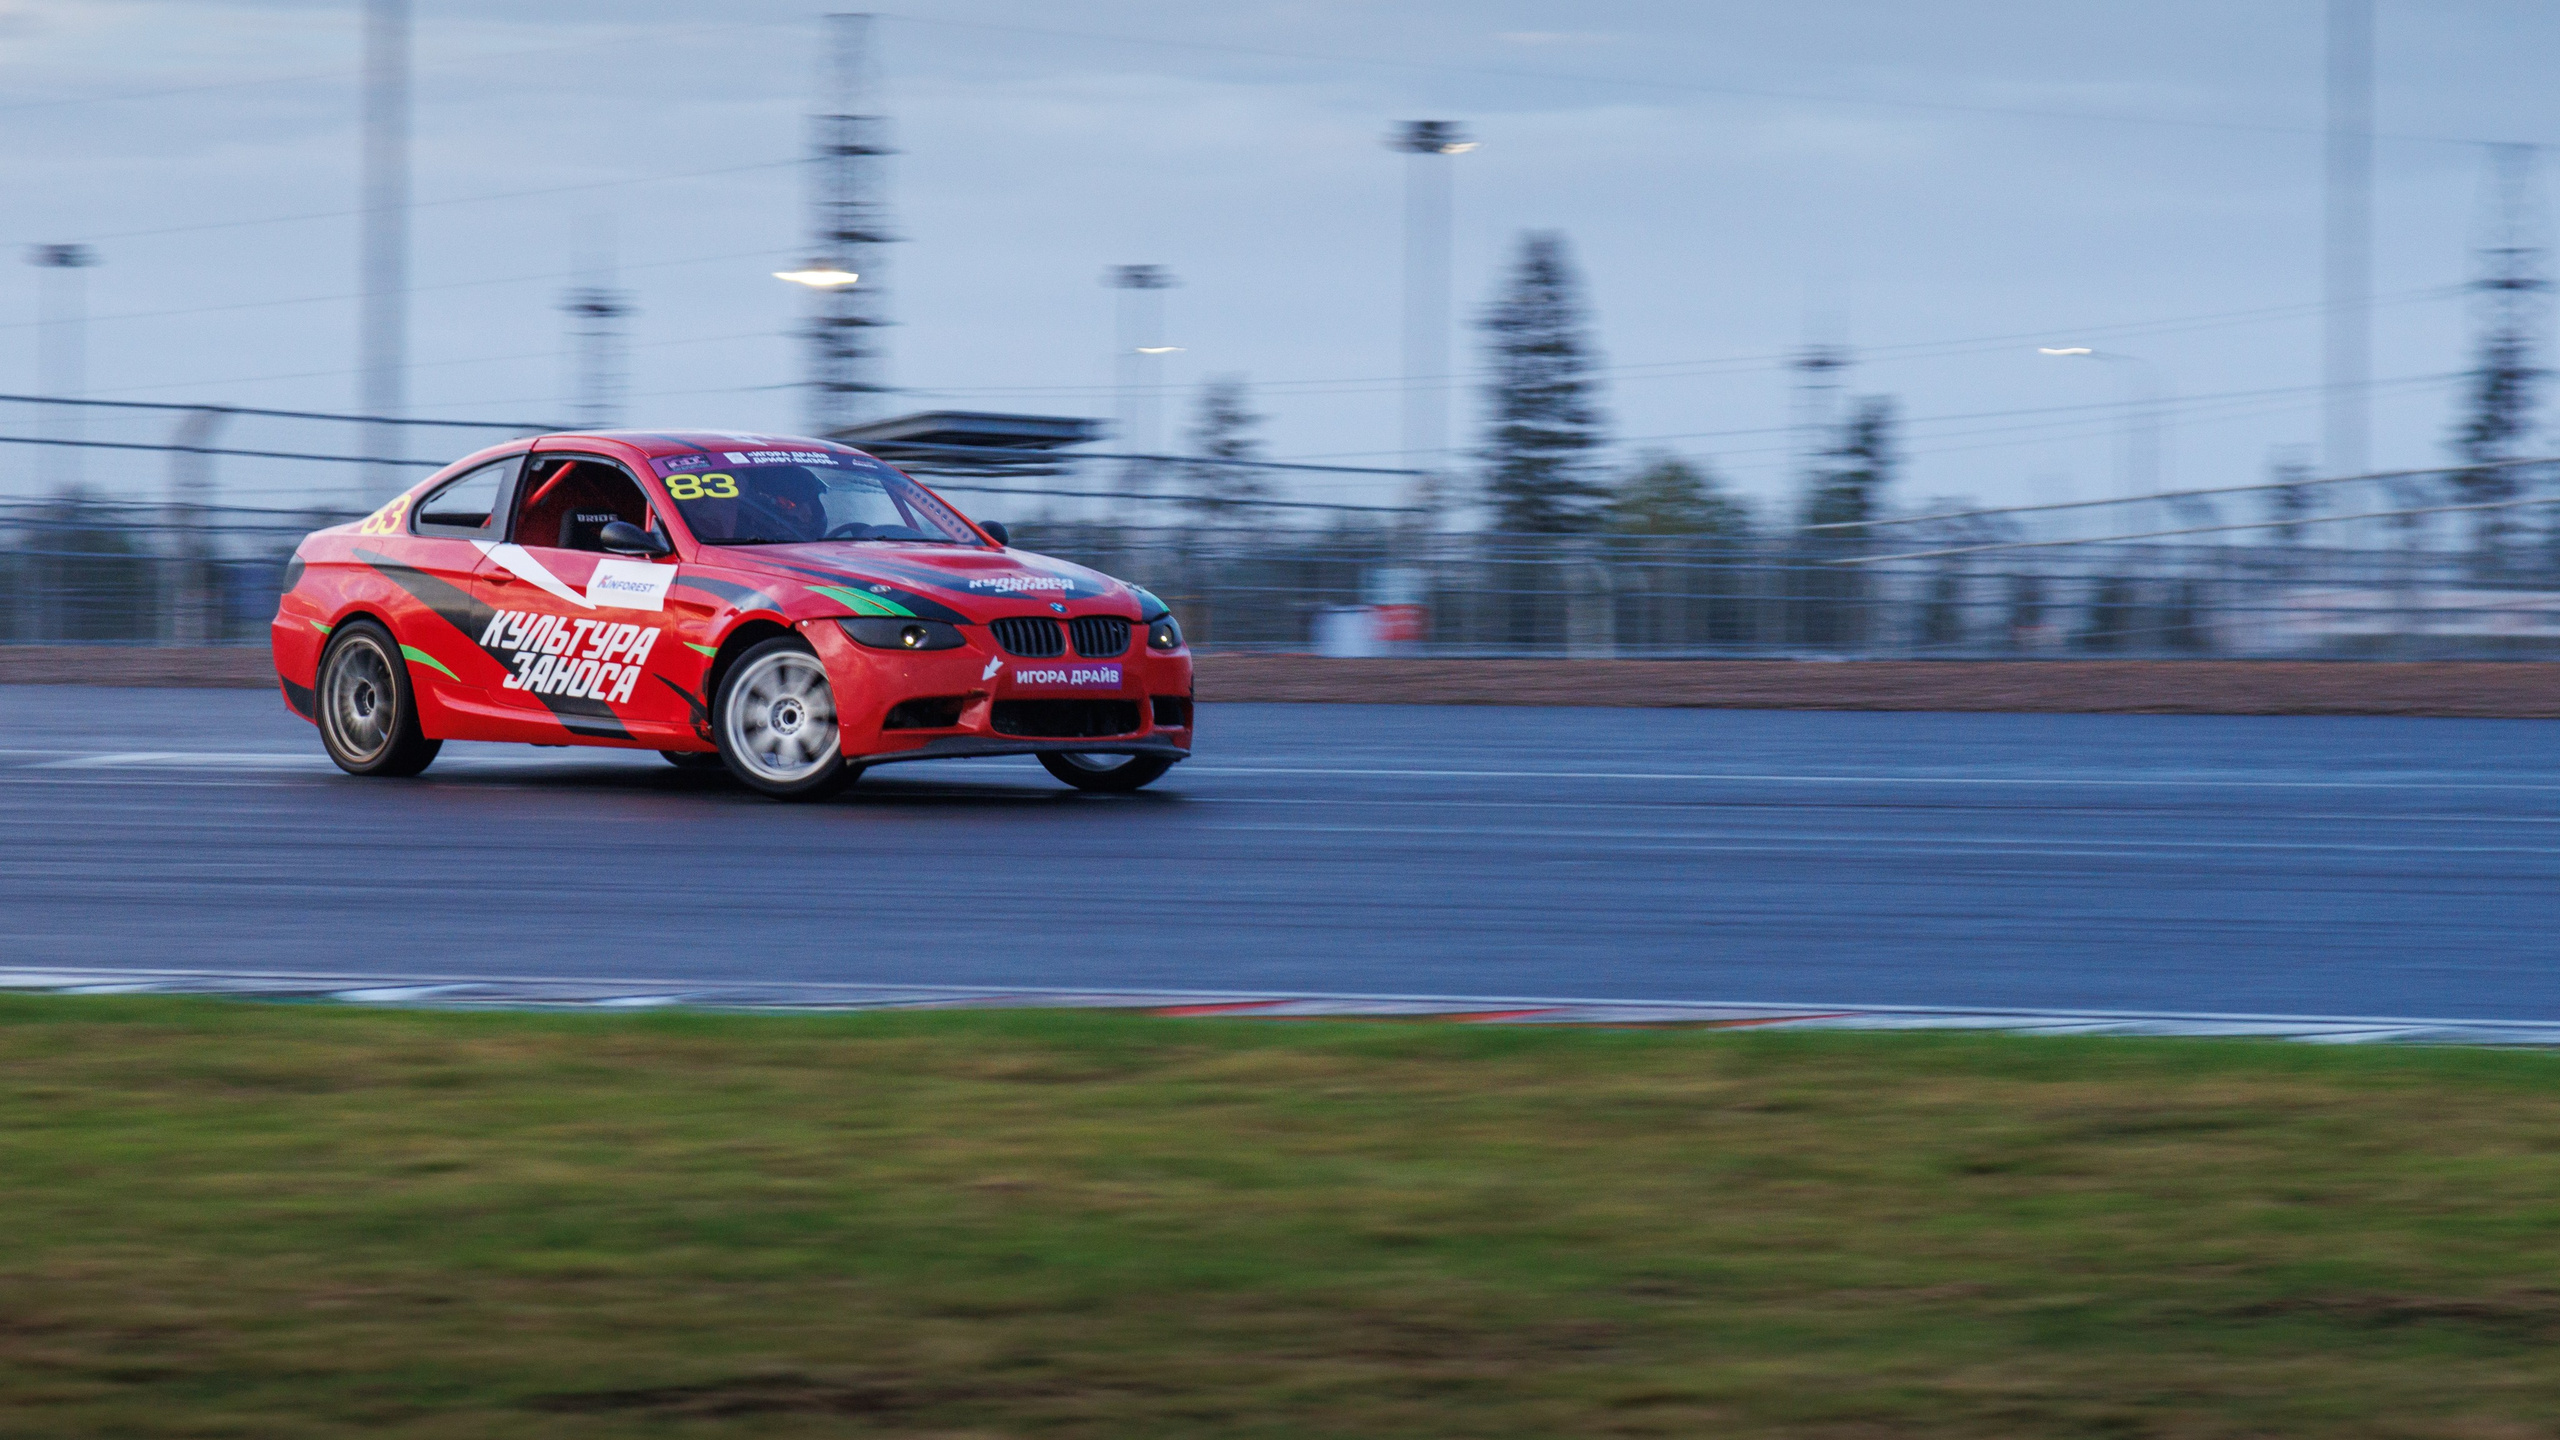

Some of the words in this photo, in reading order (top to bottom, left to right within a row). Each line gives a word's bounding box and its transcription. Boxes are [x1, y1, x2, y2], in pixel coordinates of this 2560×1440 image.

[790, 451, 829, 460] ДРАЙВ
[665, 473, 739, 500] 83
[361, 494, 412, 535] 83
[479, 609, 661, 666] КУЛЬТУРА
[502, 651, 642, 704] ЗАНОСА
[1016, 670, 1068, 684] ИГОРА
[1070, 666, 1120, 685] ДРАЙВ
